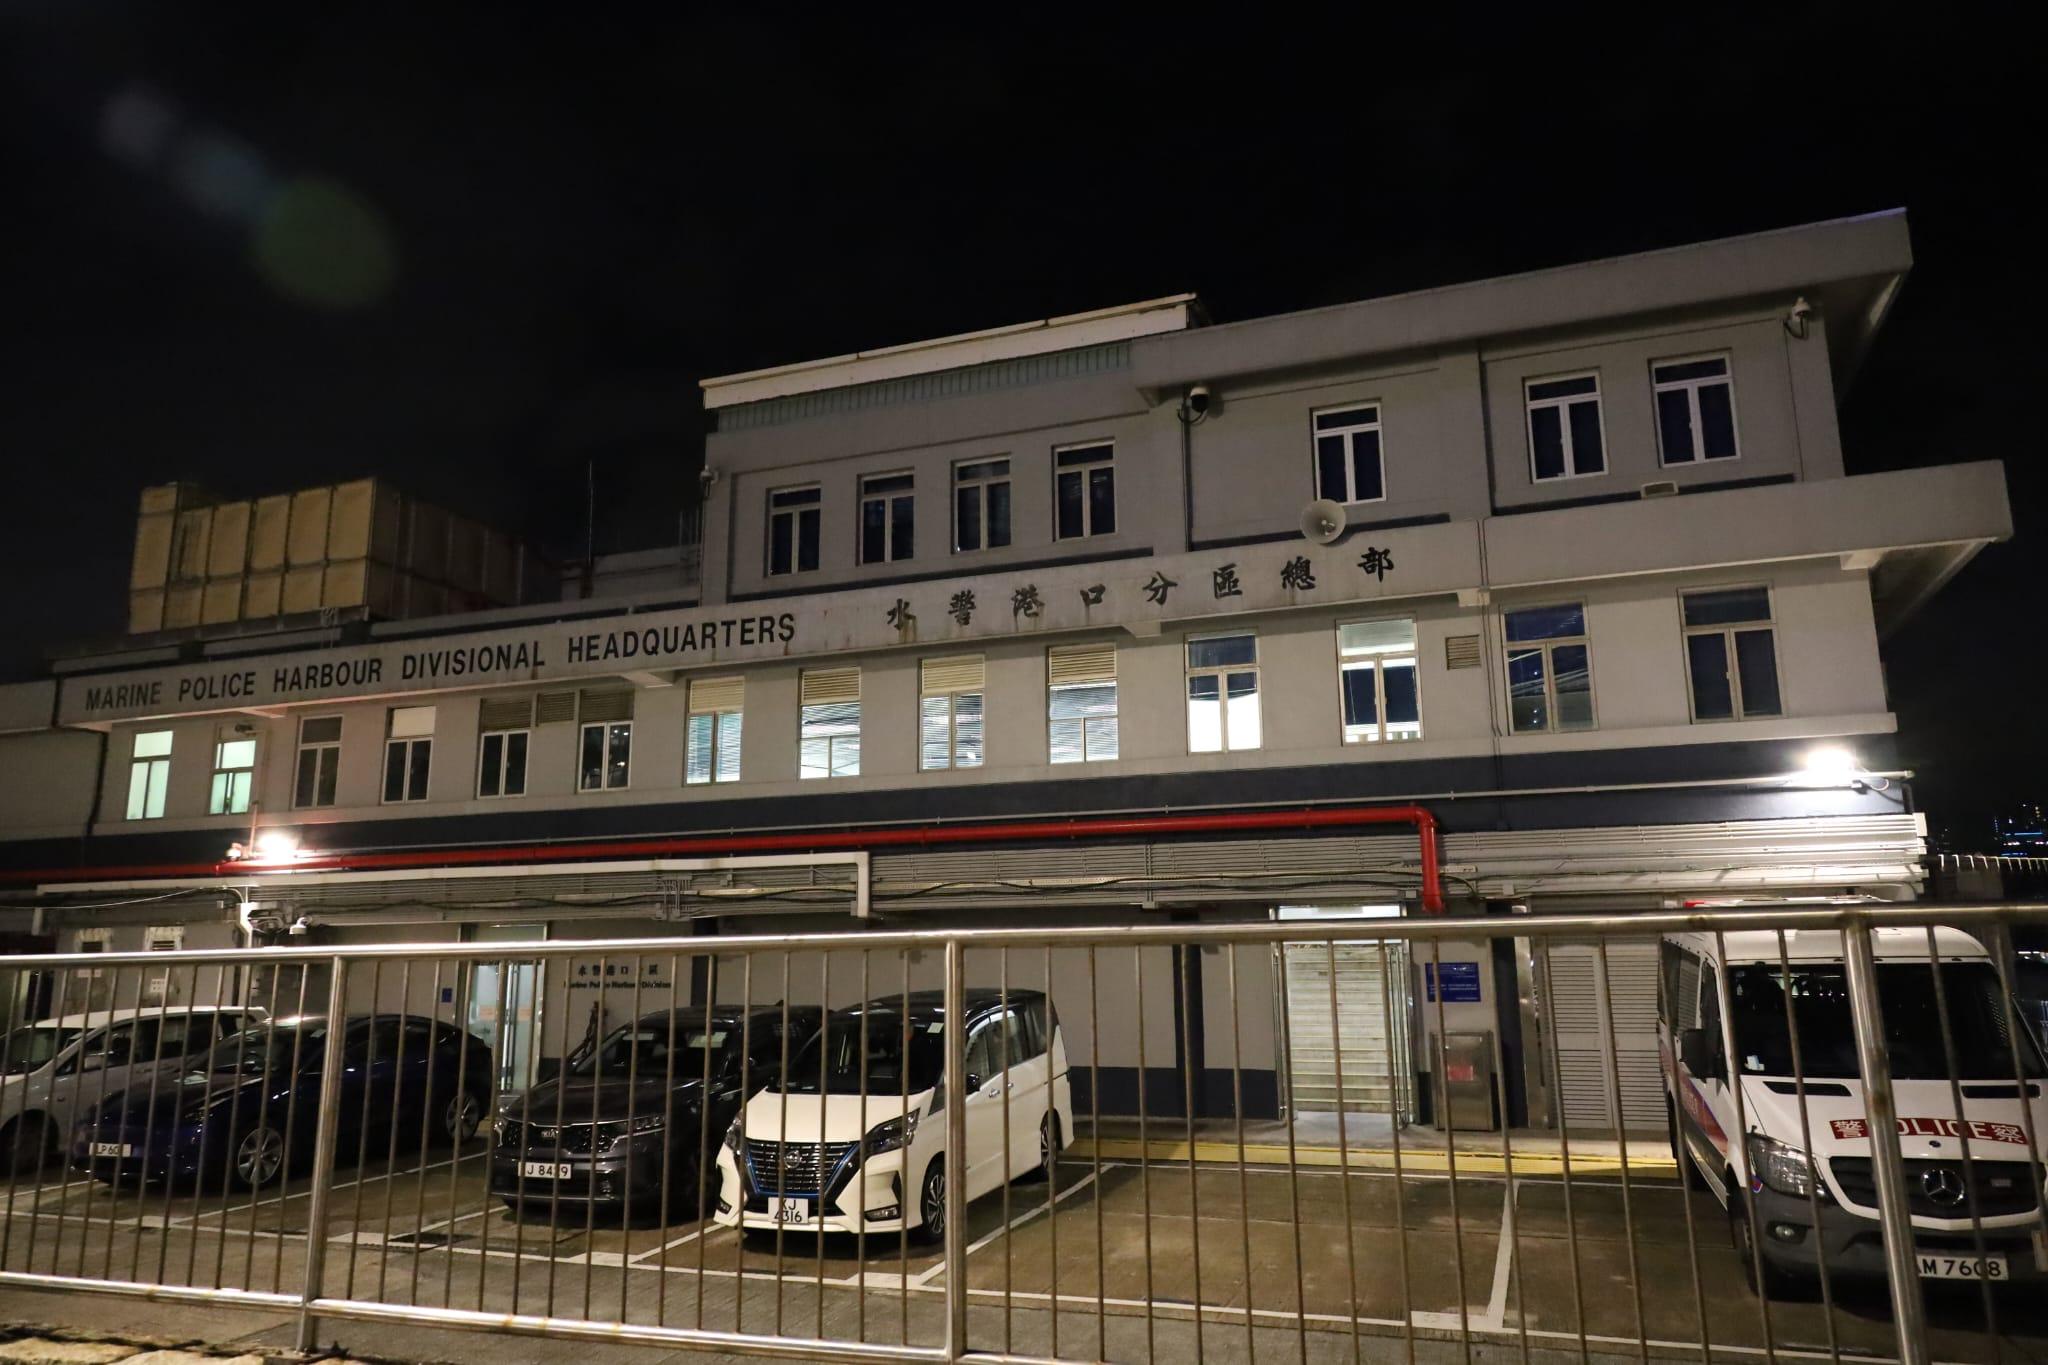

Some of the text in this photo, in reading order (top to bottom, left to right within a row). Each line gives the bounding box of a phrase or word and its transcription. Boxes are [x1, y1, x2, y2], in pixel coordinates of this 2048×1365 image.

[86, 613, 795, 711] MARINE POLICE HARBOUR DIVISIONAL HEADQUARTERS
[1833, 1119, 1866, 1138] 警
[1896, 1118, 1993, 1140] OLICE
[538, 1165, 568, 1177] 849
